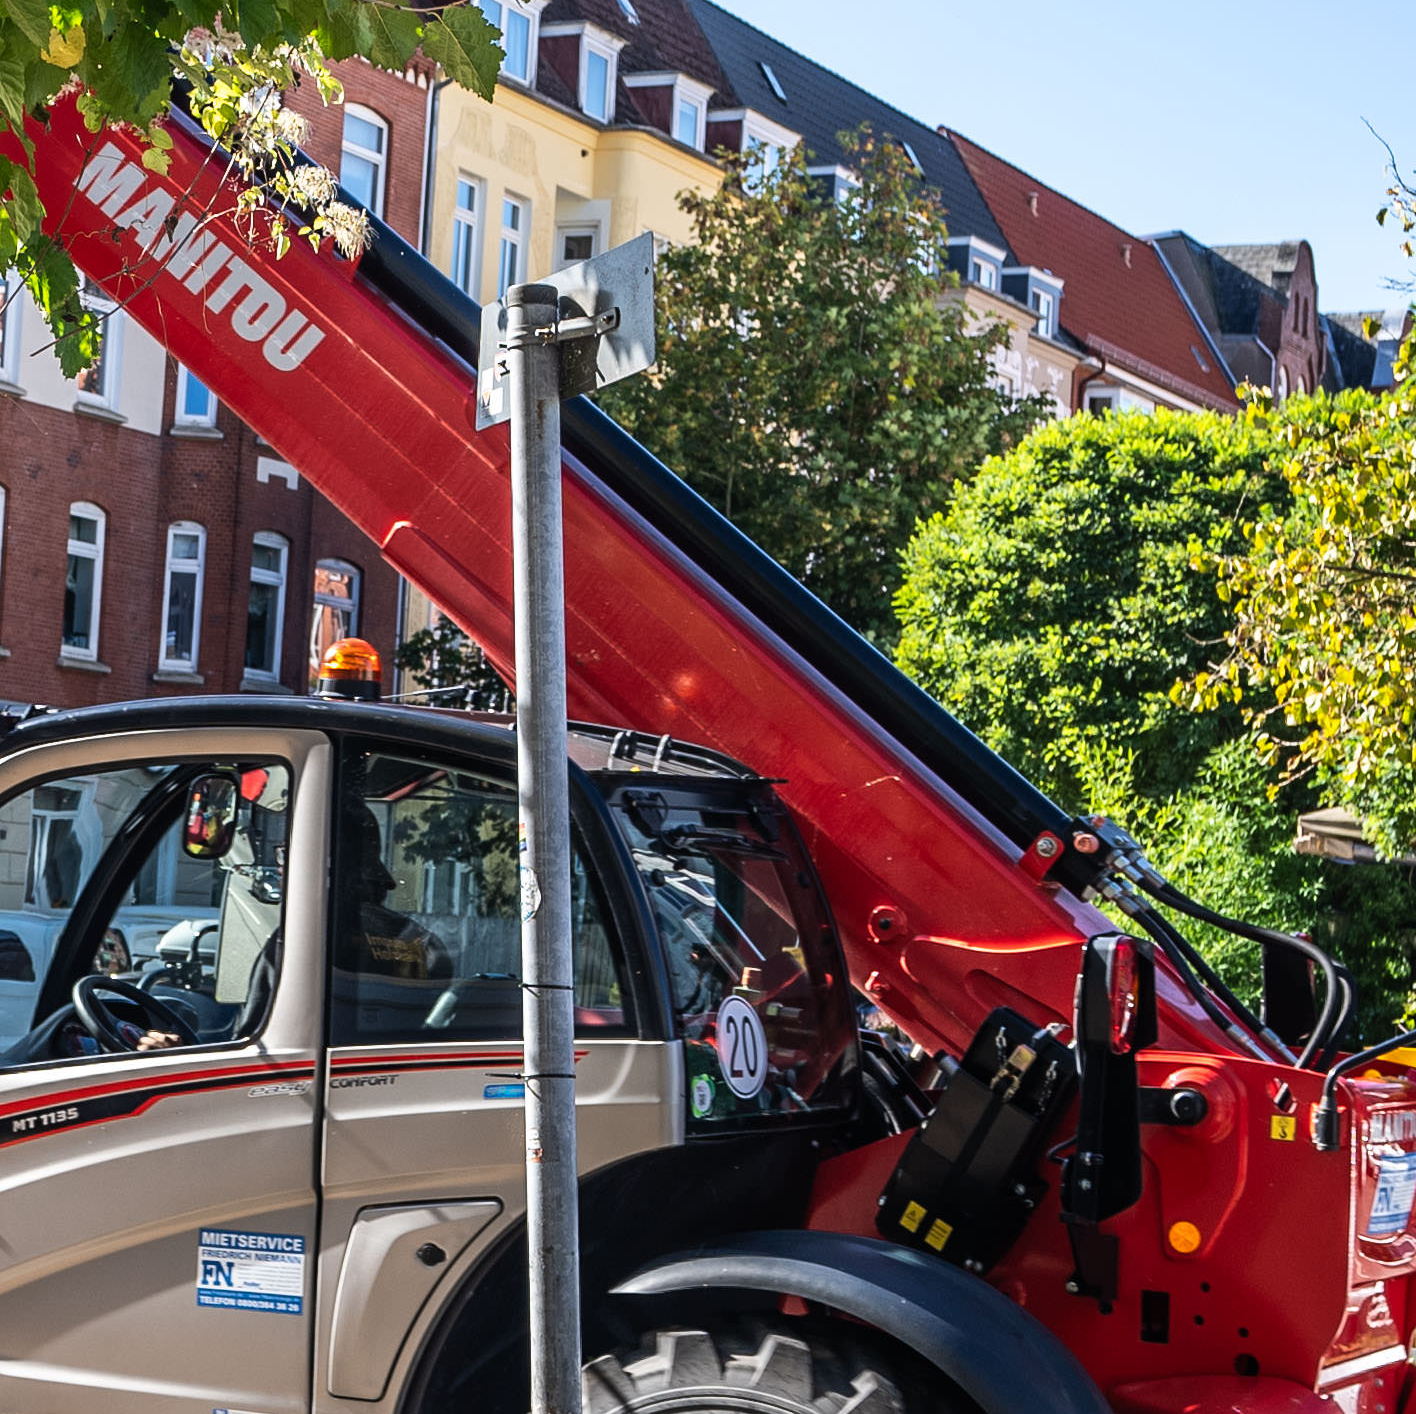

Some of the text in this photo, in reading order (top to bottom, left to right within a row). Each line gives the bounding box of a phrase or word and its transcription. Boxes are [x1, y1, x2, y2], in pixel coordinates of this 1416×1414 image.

[73, 141, 327, 372] MANITOU
[726, 1015, 758, 1078] 20
[12, 1107, 80, 1133] MT 1135
[201, 1231, 303, 1252] MIETSERVICE
[201, 1249, 302, 1265] FRIEDRICH NIEMANN
[201, 1259, 235, 1288] FN
[199, 1294, 236, 1306] TELEFON
